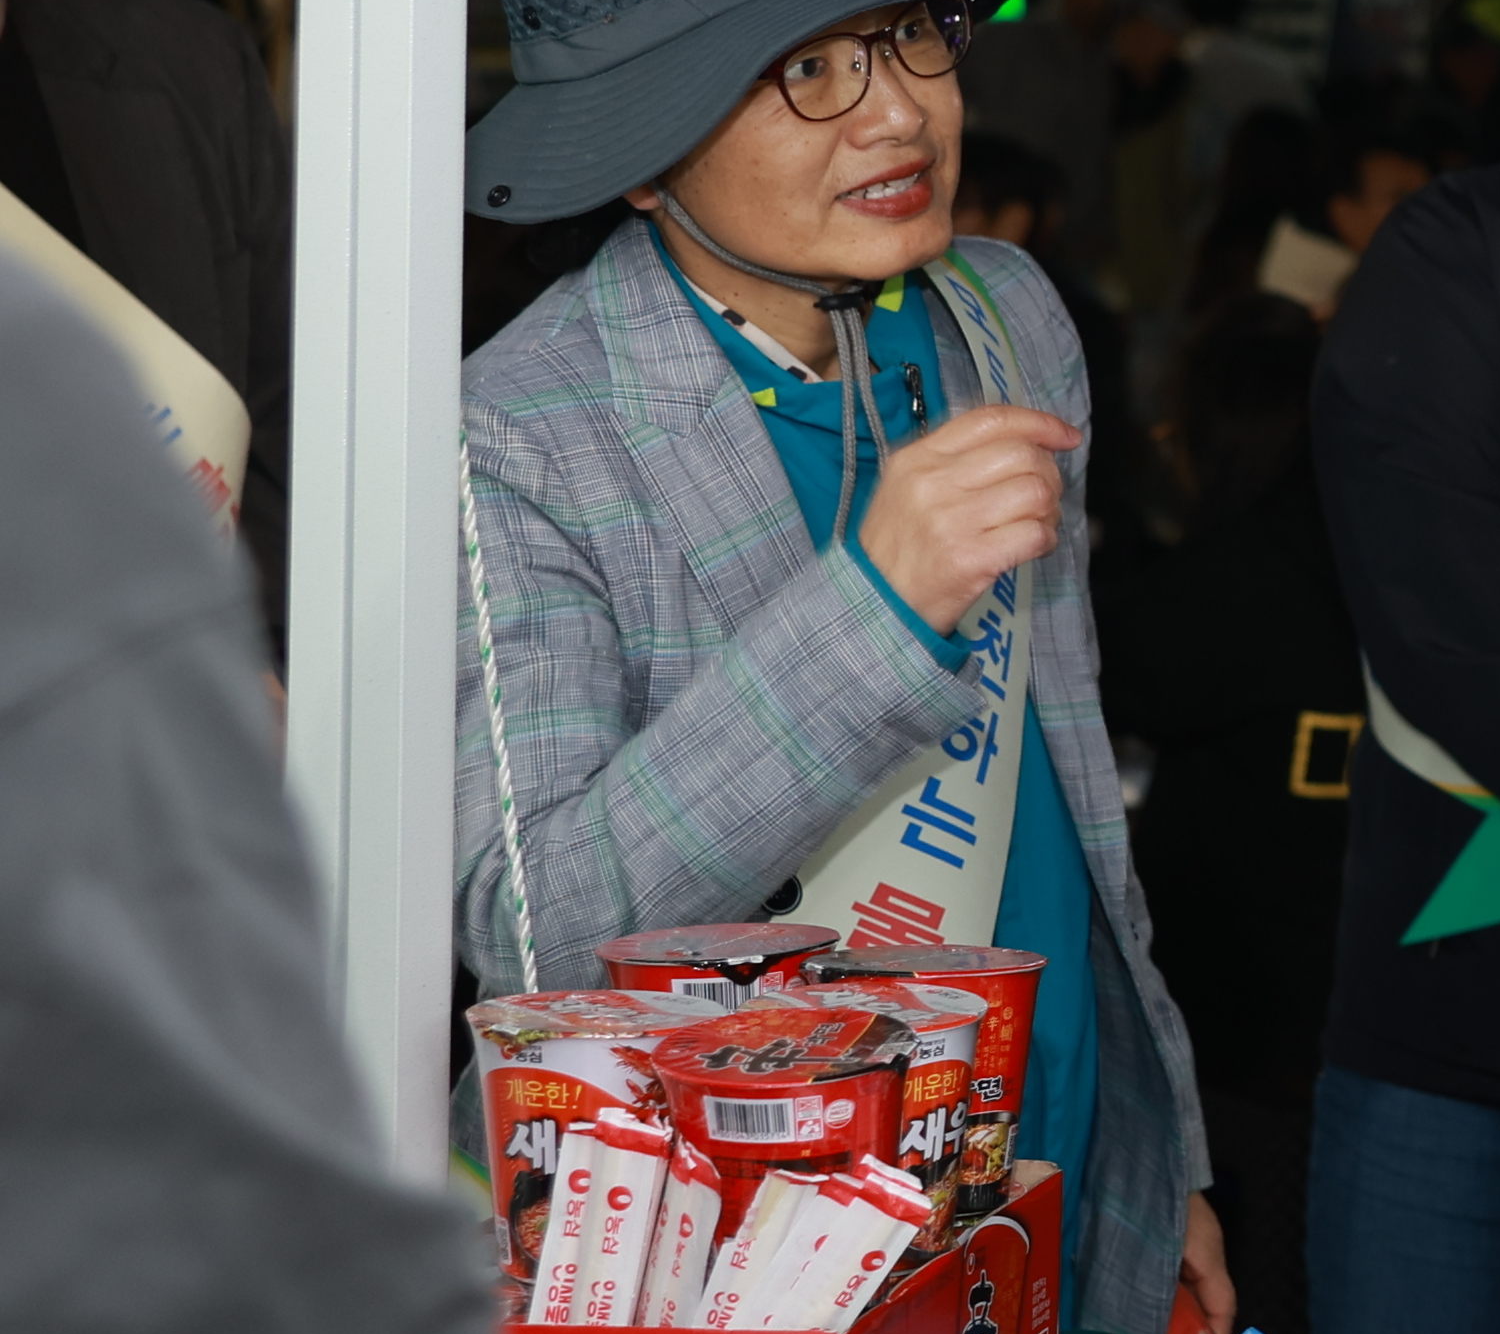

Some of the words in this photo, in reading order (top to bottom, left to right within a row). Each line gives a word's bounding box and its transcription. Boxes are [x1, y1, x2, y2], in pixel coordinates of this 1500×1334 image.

[919, 1045, 946, 1060] 농심
[506, 1079, 583, 1110] 개운한!
[905, 1066, 965, 1104] 개운한!
[563, 1199, 587, 1238] 농심
[601, 1215, 625, 1255] 농심
[834, 1274, 869, 1309] 농심
